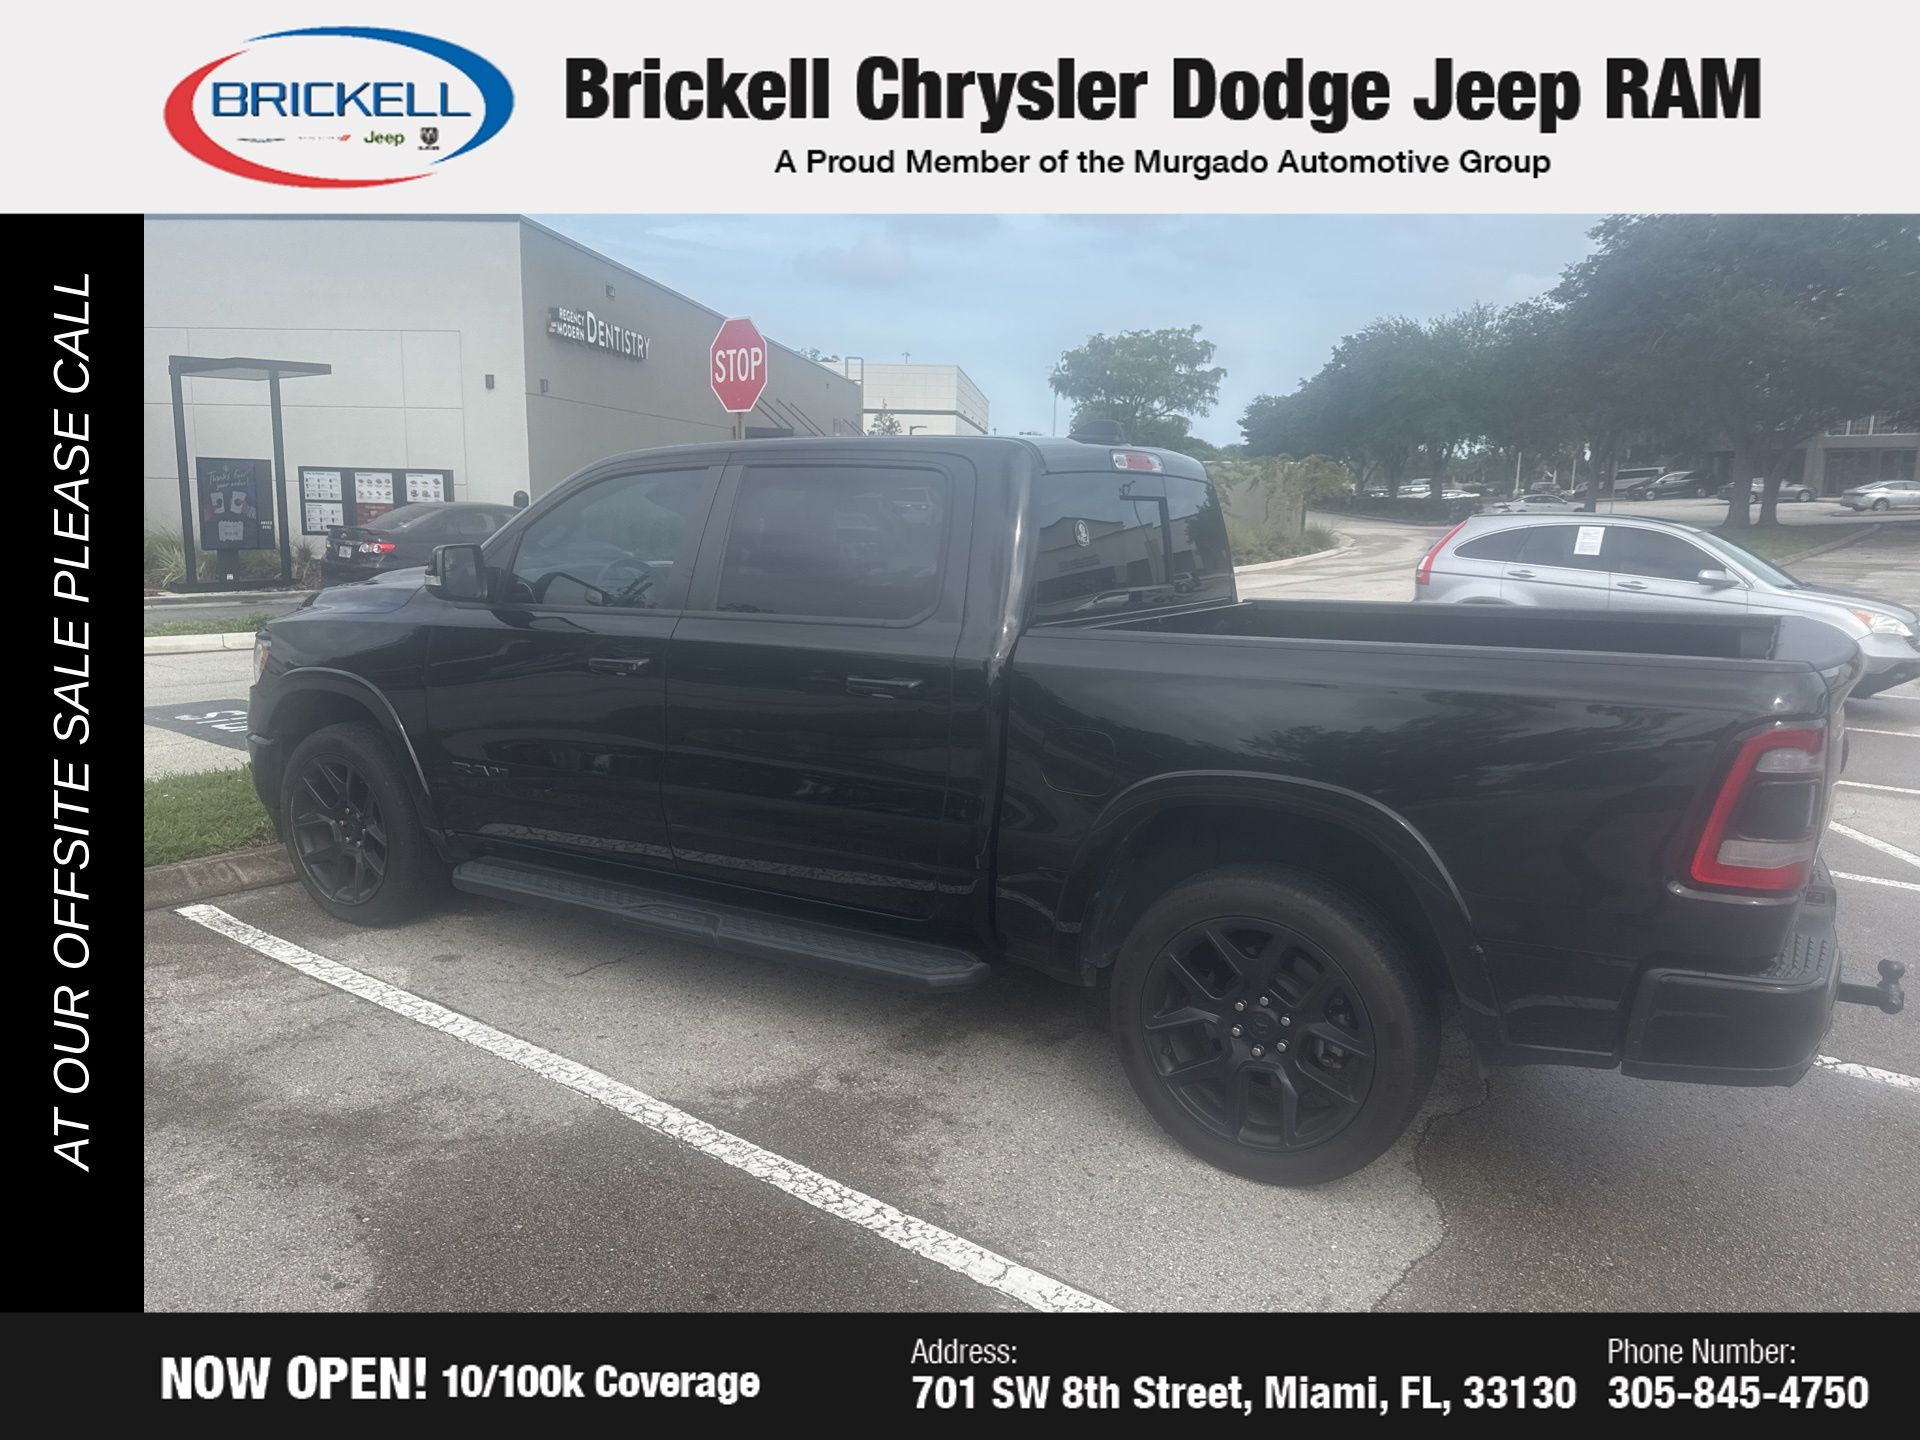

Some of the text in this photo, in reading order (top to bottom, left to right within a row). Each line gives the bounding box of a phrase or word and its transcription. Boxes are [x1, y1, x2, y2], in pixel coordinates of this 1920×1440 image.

[559, 307, 585, 326] REGENCY
[557, 321, 585, 341] MODERN
[587, 311, 651, 360] DENTISTRY
[714, 346, 763, 383] STOP
